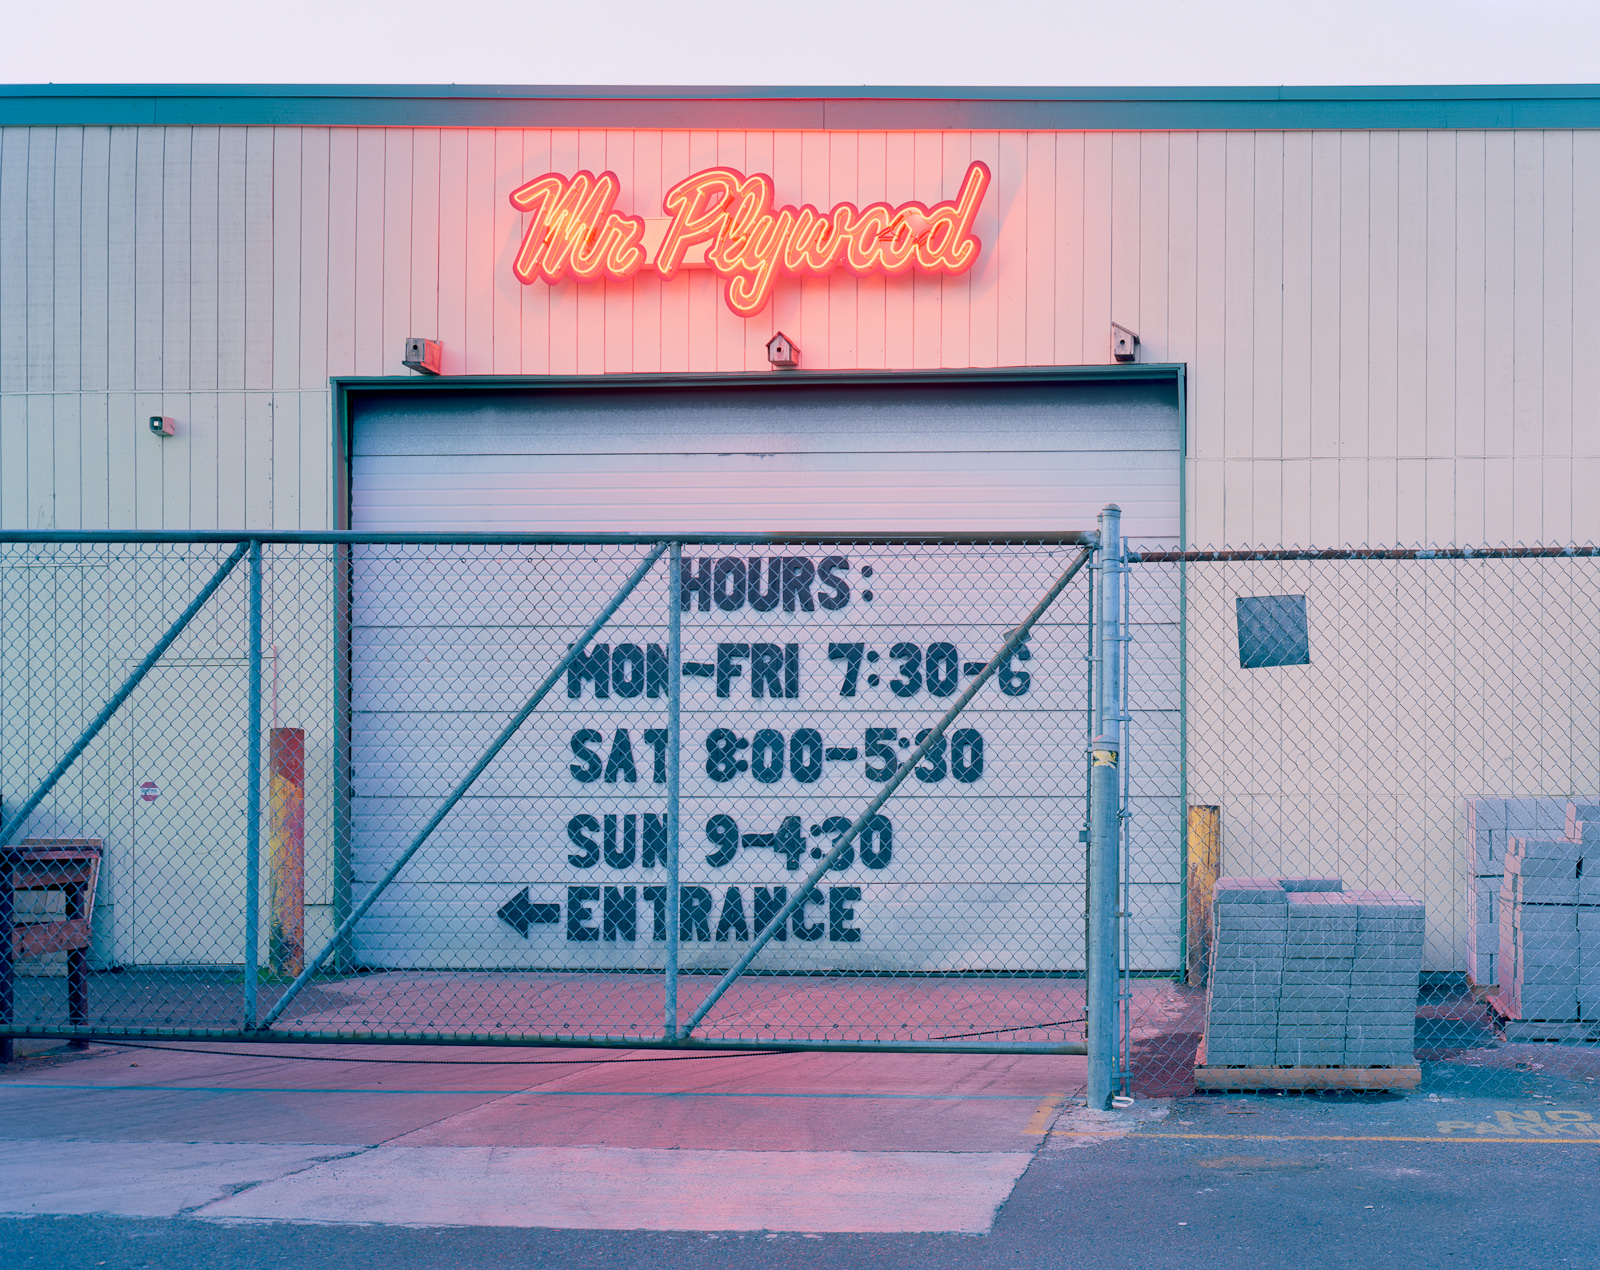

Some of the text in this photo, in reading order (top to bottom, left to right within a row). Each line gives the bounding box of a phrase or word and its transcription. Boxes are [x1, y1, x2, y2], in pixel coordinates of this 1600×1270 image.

[653, 160, 991, 317] Plywood
[680, 556, 873, 612] HOURS:
[567, 641, 1030, 698] MON-FRI 7:30-6
[570, 727, 983, 784] SAT 8:00-5:30
[567, 813, 892, 871] SUN 9-4:30
[567, 886, 861, 942] ENTRANCE
[1494, 1110, 1593, 1122] NO
